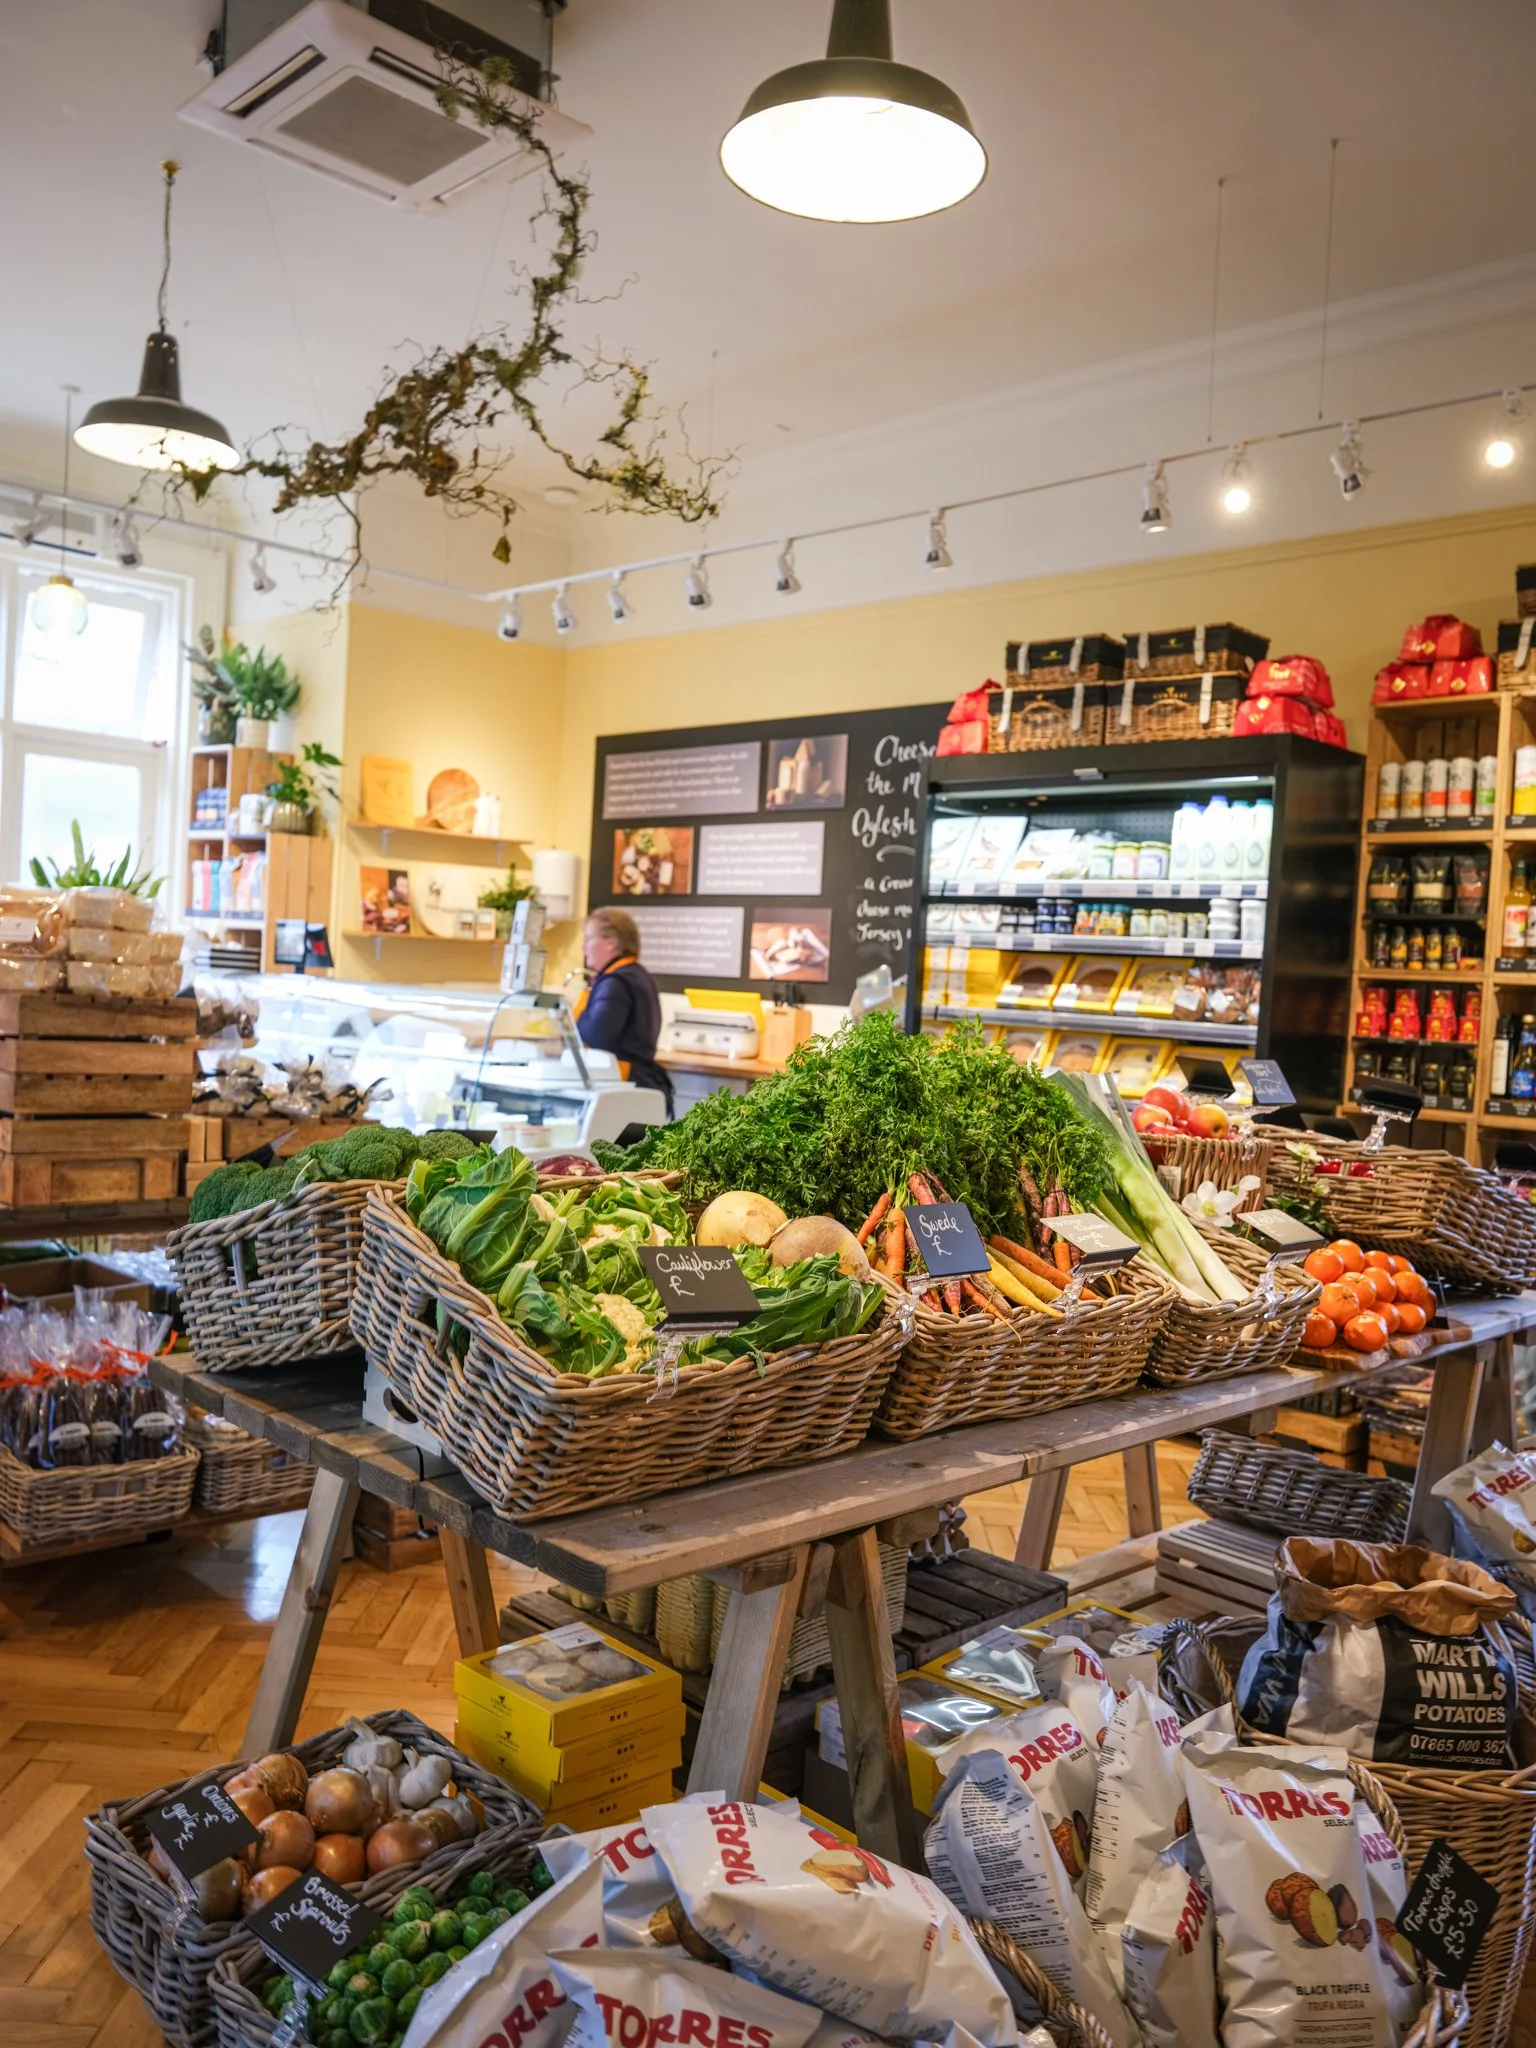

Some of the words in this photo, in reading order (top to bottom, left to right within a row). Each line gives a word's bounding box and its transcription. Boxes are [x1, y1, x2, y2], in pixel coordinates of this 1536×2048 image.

[865, 770, 895, 796] the
[851, 804, 919, 849] Oglesh
[919, 1213, 963, 1238] Swede
[931, 1236, 952, 1256] £
[655, 1254, 733, 1280] Cauliflower
[668, 1278, 696, 1297] £
[1415, 1669, 1508, 1701] WILLS
[1413, 1703, 1506, 1724] POTATOES
[1007, 1722, 1082, 1782] ORRES
[1069, 1746, 1089, 1762] SELECTA
[1409, 1734, 1455, 1753] 07865
[1456, 1739, 1481, 1753] 000
[1482, 1739, 1507, 1754] 362
[201, 1784, 240, 1825] Onions
[749, 1802, 759, 1828] SELECT
[202, 1811, 220, 1829] £
[173, 1831, 194, 1852] £
[706, 1801, 767, 1886] ORRES
[302, 1876, 361, 1920] Brussel
[270, 1911, 291, 1933] £
[290, 1897, 352, 1946] Sprouts
[1175, 1878, 1209, 1956] TORR
[1296, 1985, 1329, 1996] BLACK
[1330, 1983, 1371, 1995] TRUFFLE
[1308, 2000, 1336, 2012] TRUFA
[1336, 1999, 1365, 2011] NEGRA
[595, 1993, 774, 2048] TORRES
